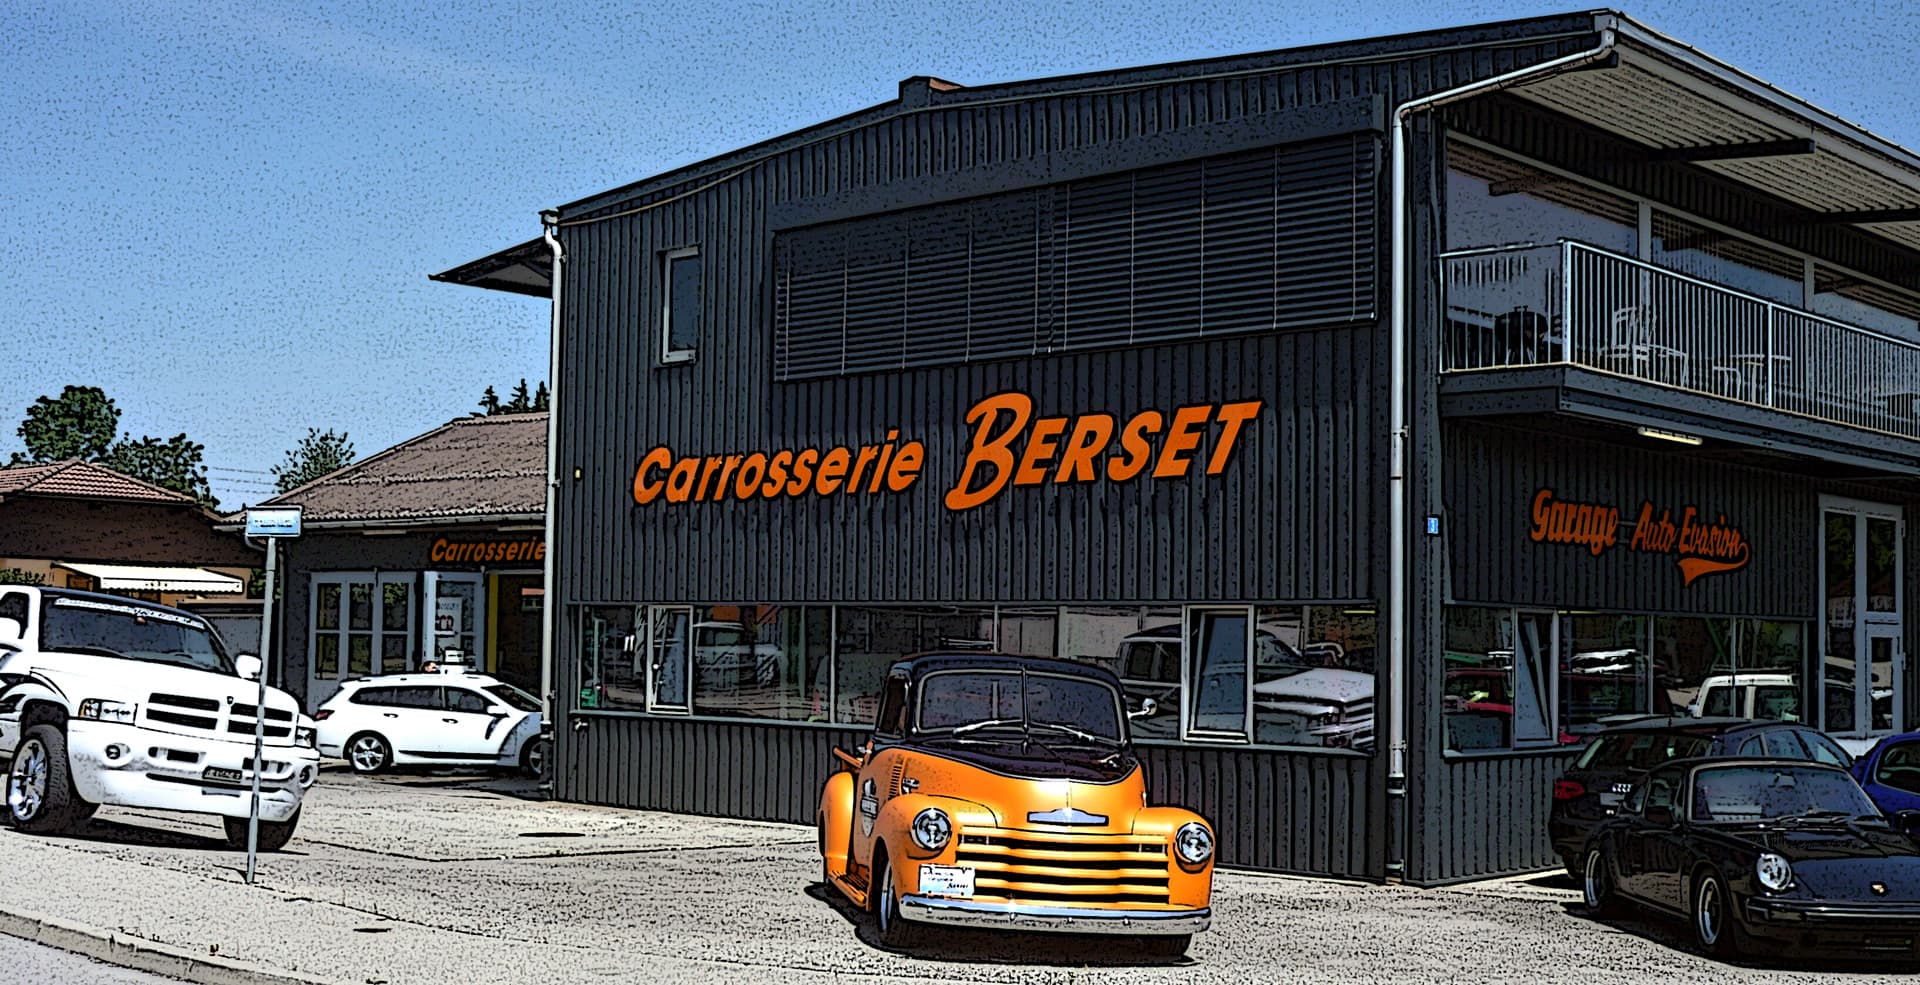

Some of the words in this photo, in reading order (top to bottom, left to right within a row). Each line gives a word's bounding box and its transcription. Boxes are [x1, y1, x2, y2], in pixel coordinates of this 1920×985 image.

[633, 430, 924, 505] Carrosserie
[945, 392, 1262, 510] BERSET
[431, 536, 546, 561] Carrosserie
[1531, 489, 1619, 555] Garage
[1631, 501, 1677, 553] Auto
[1678, 507, 1742, 558] Evasion
